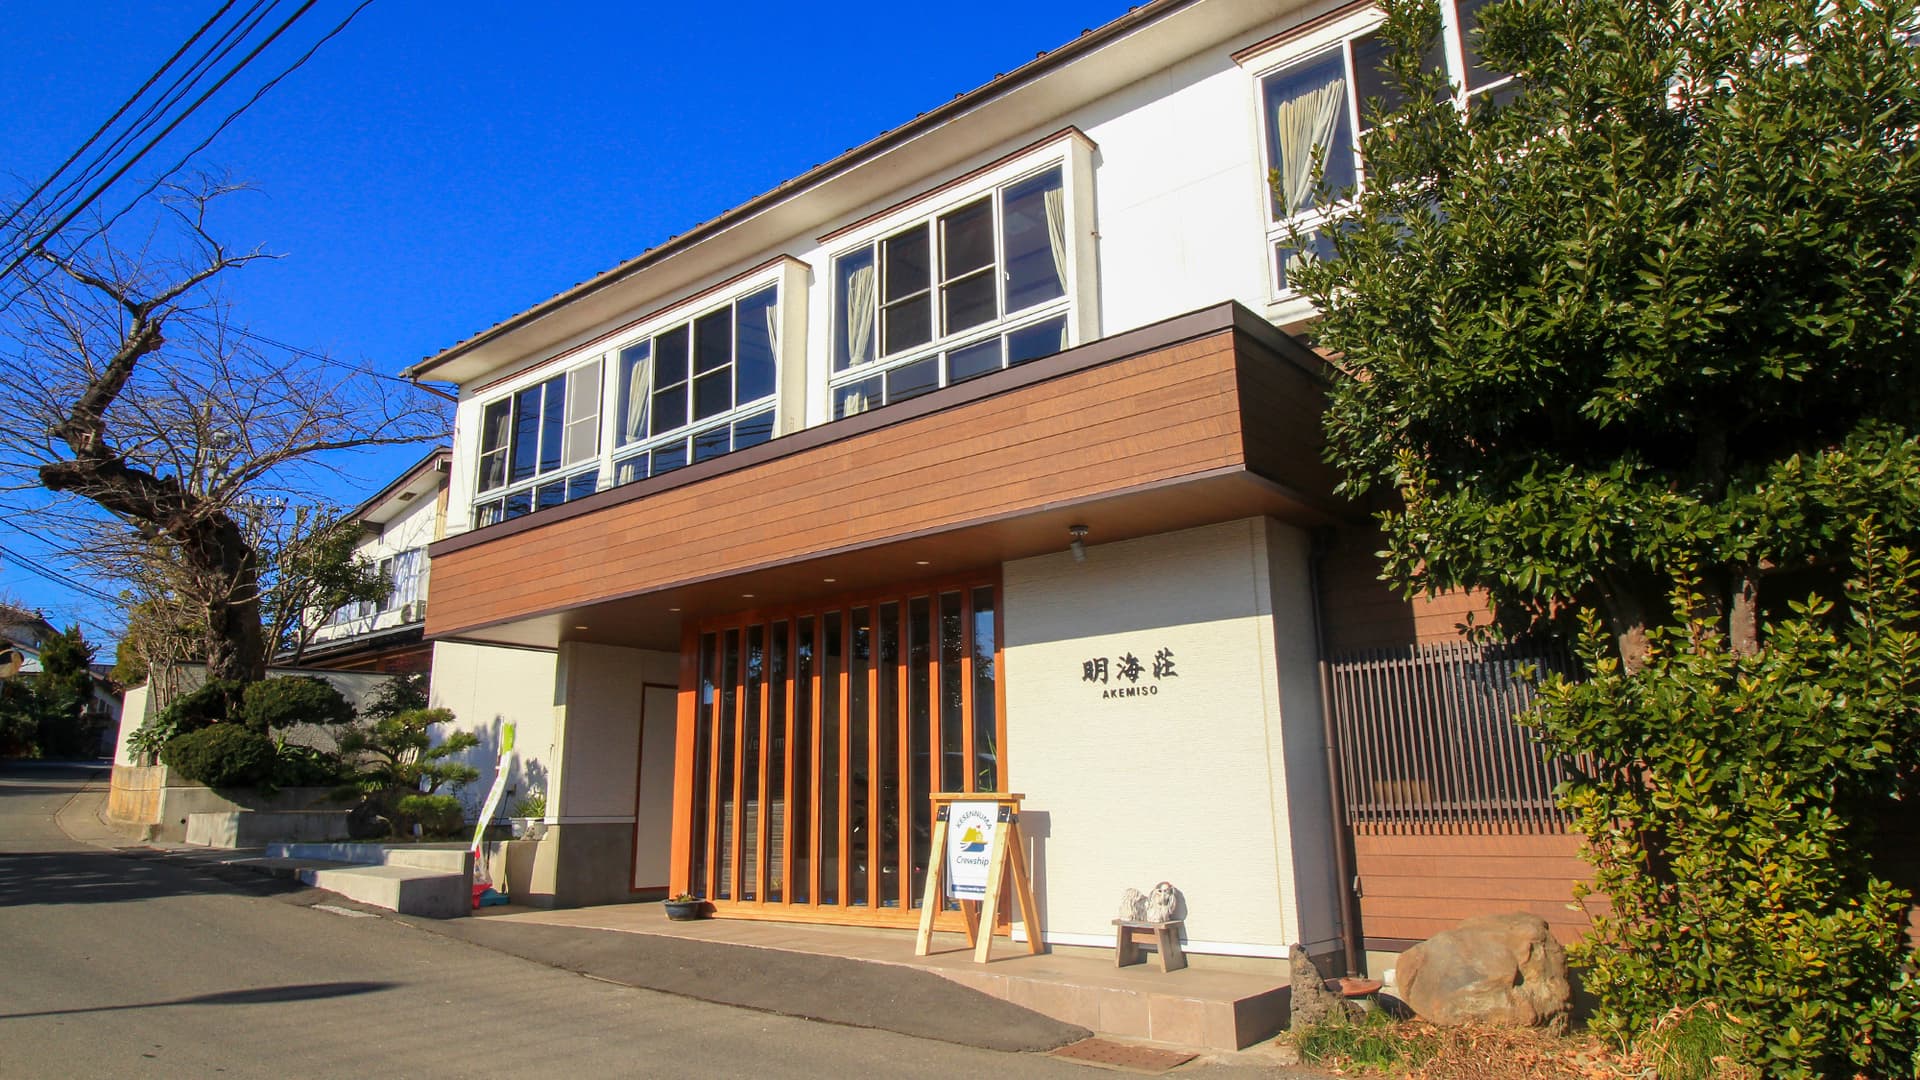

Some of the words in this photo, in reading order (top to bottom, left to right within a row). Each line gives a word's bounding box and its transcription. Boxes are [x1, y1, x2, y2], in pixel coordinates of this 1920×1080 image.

[1082, 647, 1178, 684] 明海荘
[1102, 685, 1158, 699] AKEMISO
[956, 810, 992, 830] KESENNUMA
[956, 855, 989, 868] Crewship
